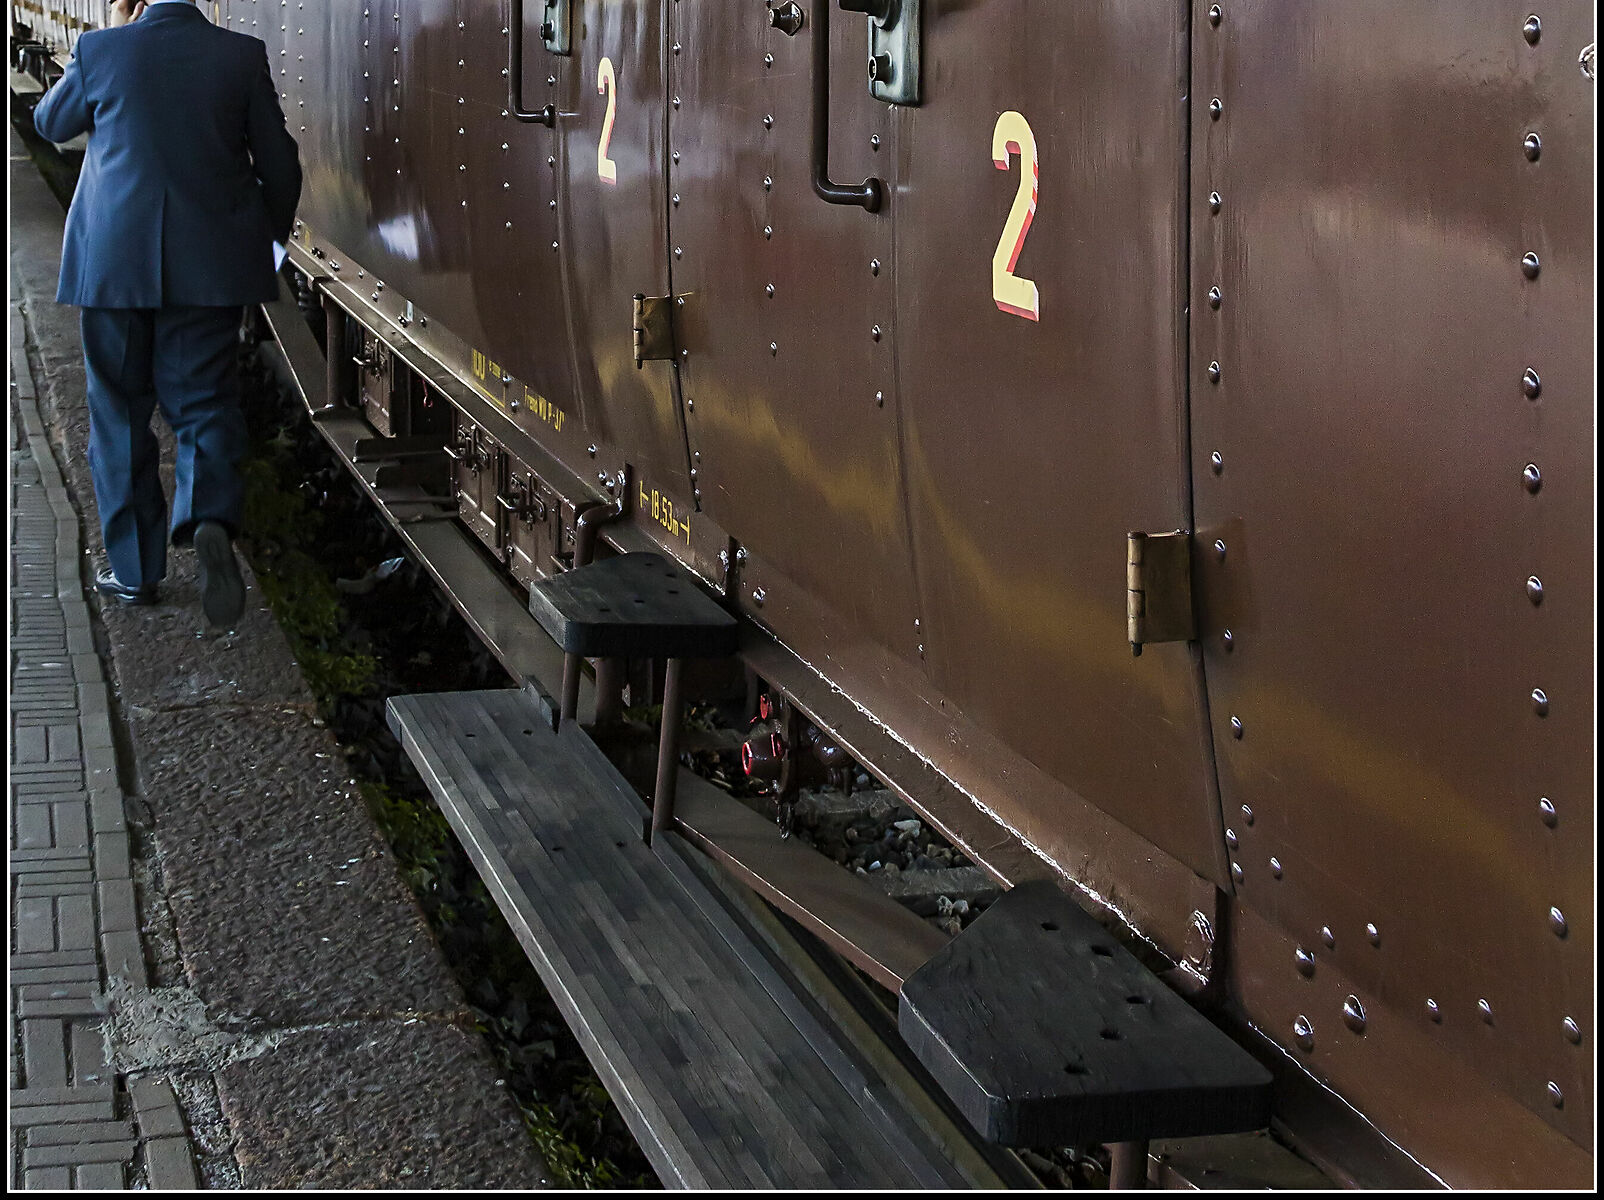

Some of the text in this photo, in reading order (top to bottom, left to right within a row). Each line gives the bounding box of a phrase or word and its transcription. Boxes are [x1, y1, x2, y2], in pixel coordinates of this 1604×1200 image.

[597, 57, 617, 185] 2
[992, 110, 1039, 322] 2
[651, 489, 679, 536] 18.53m
